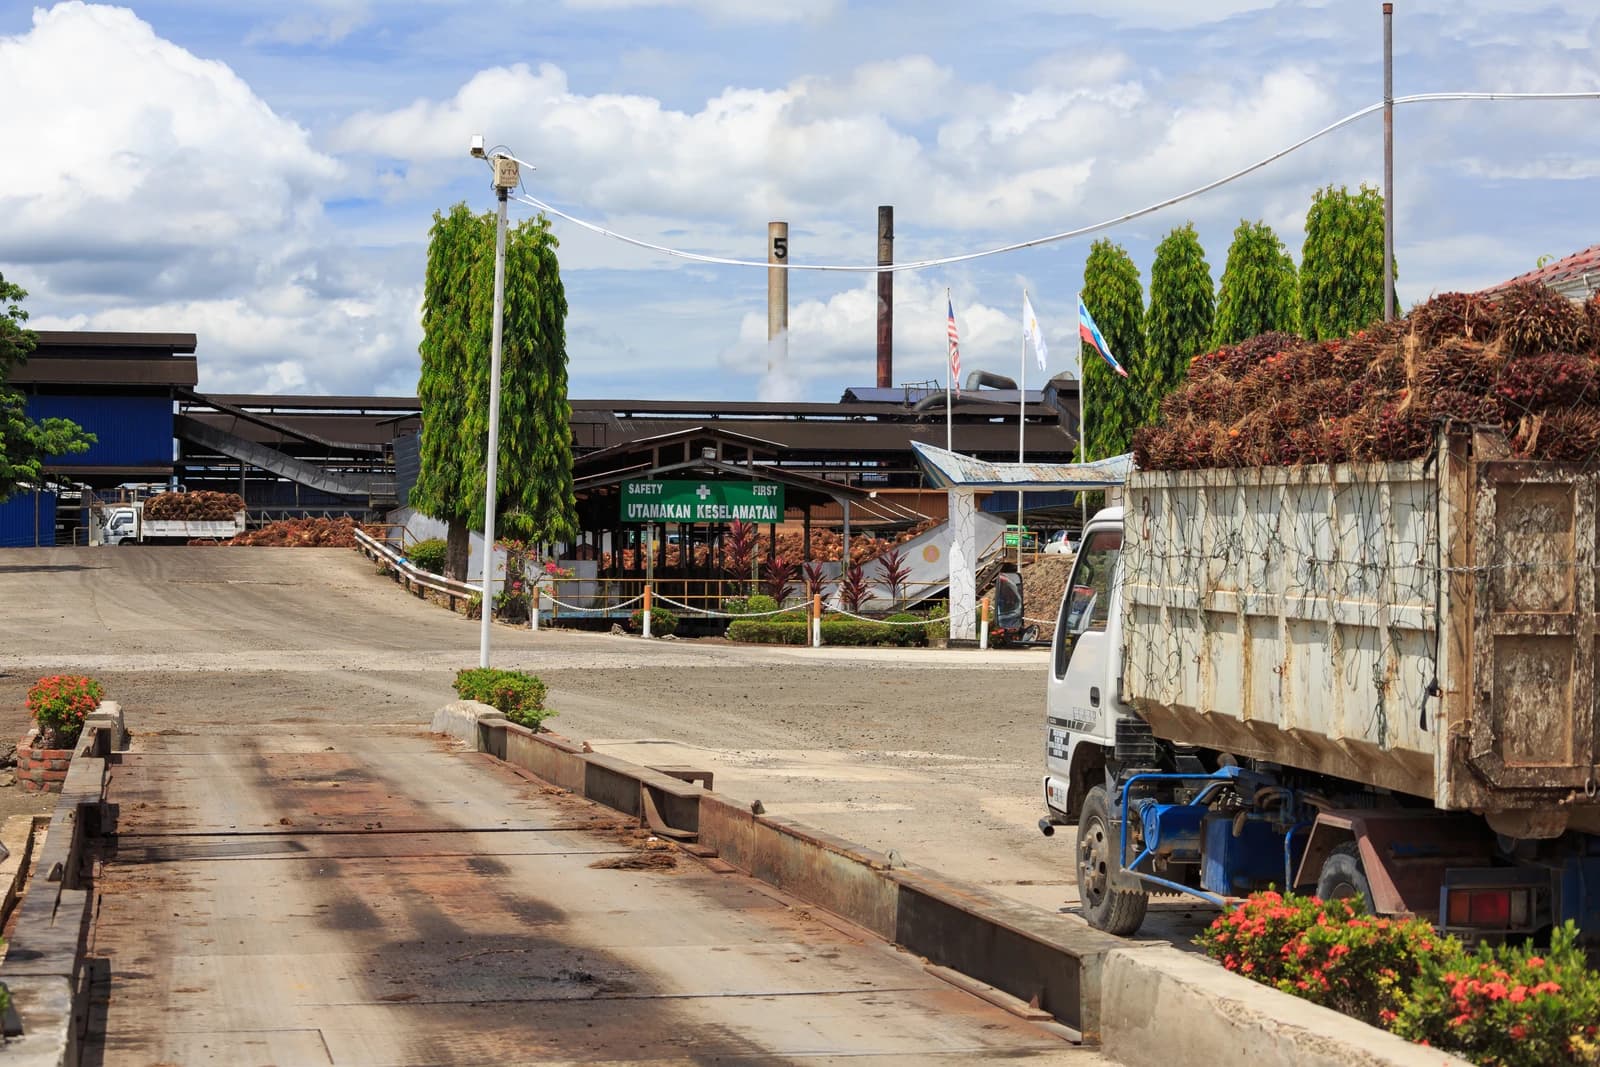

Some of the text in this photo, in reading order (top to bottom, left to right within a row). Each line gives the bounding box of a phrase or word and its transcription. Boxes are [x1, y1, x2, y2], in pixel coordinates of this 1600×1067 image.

[774, 237, 788, 259] 5
[628, 483, 778, 496] SAFETY FIRST
[628, 503, 778, 519] UTAMAKAN KESELAMATAN
